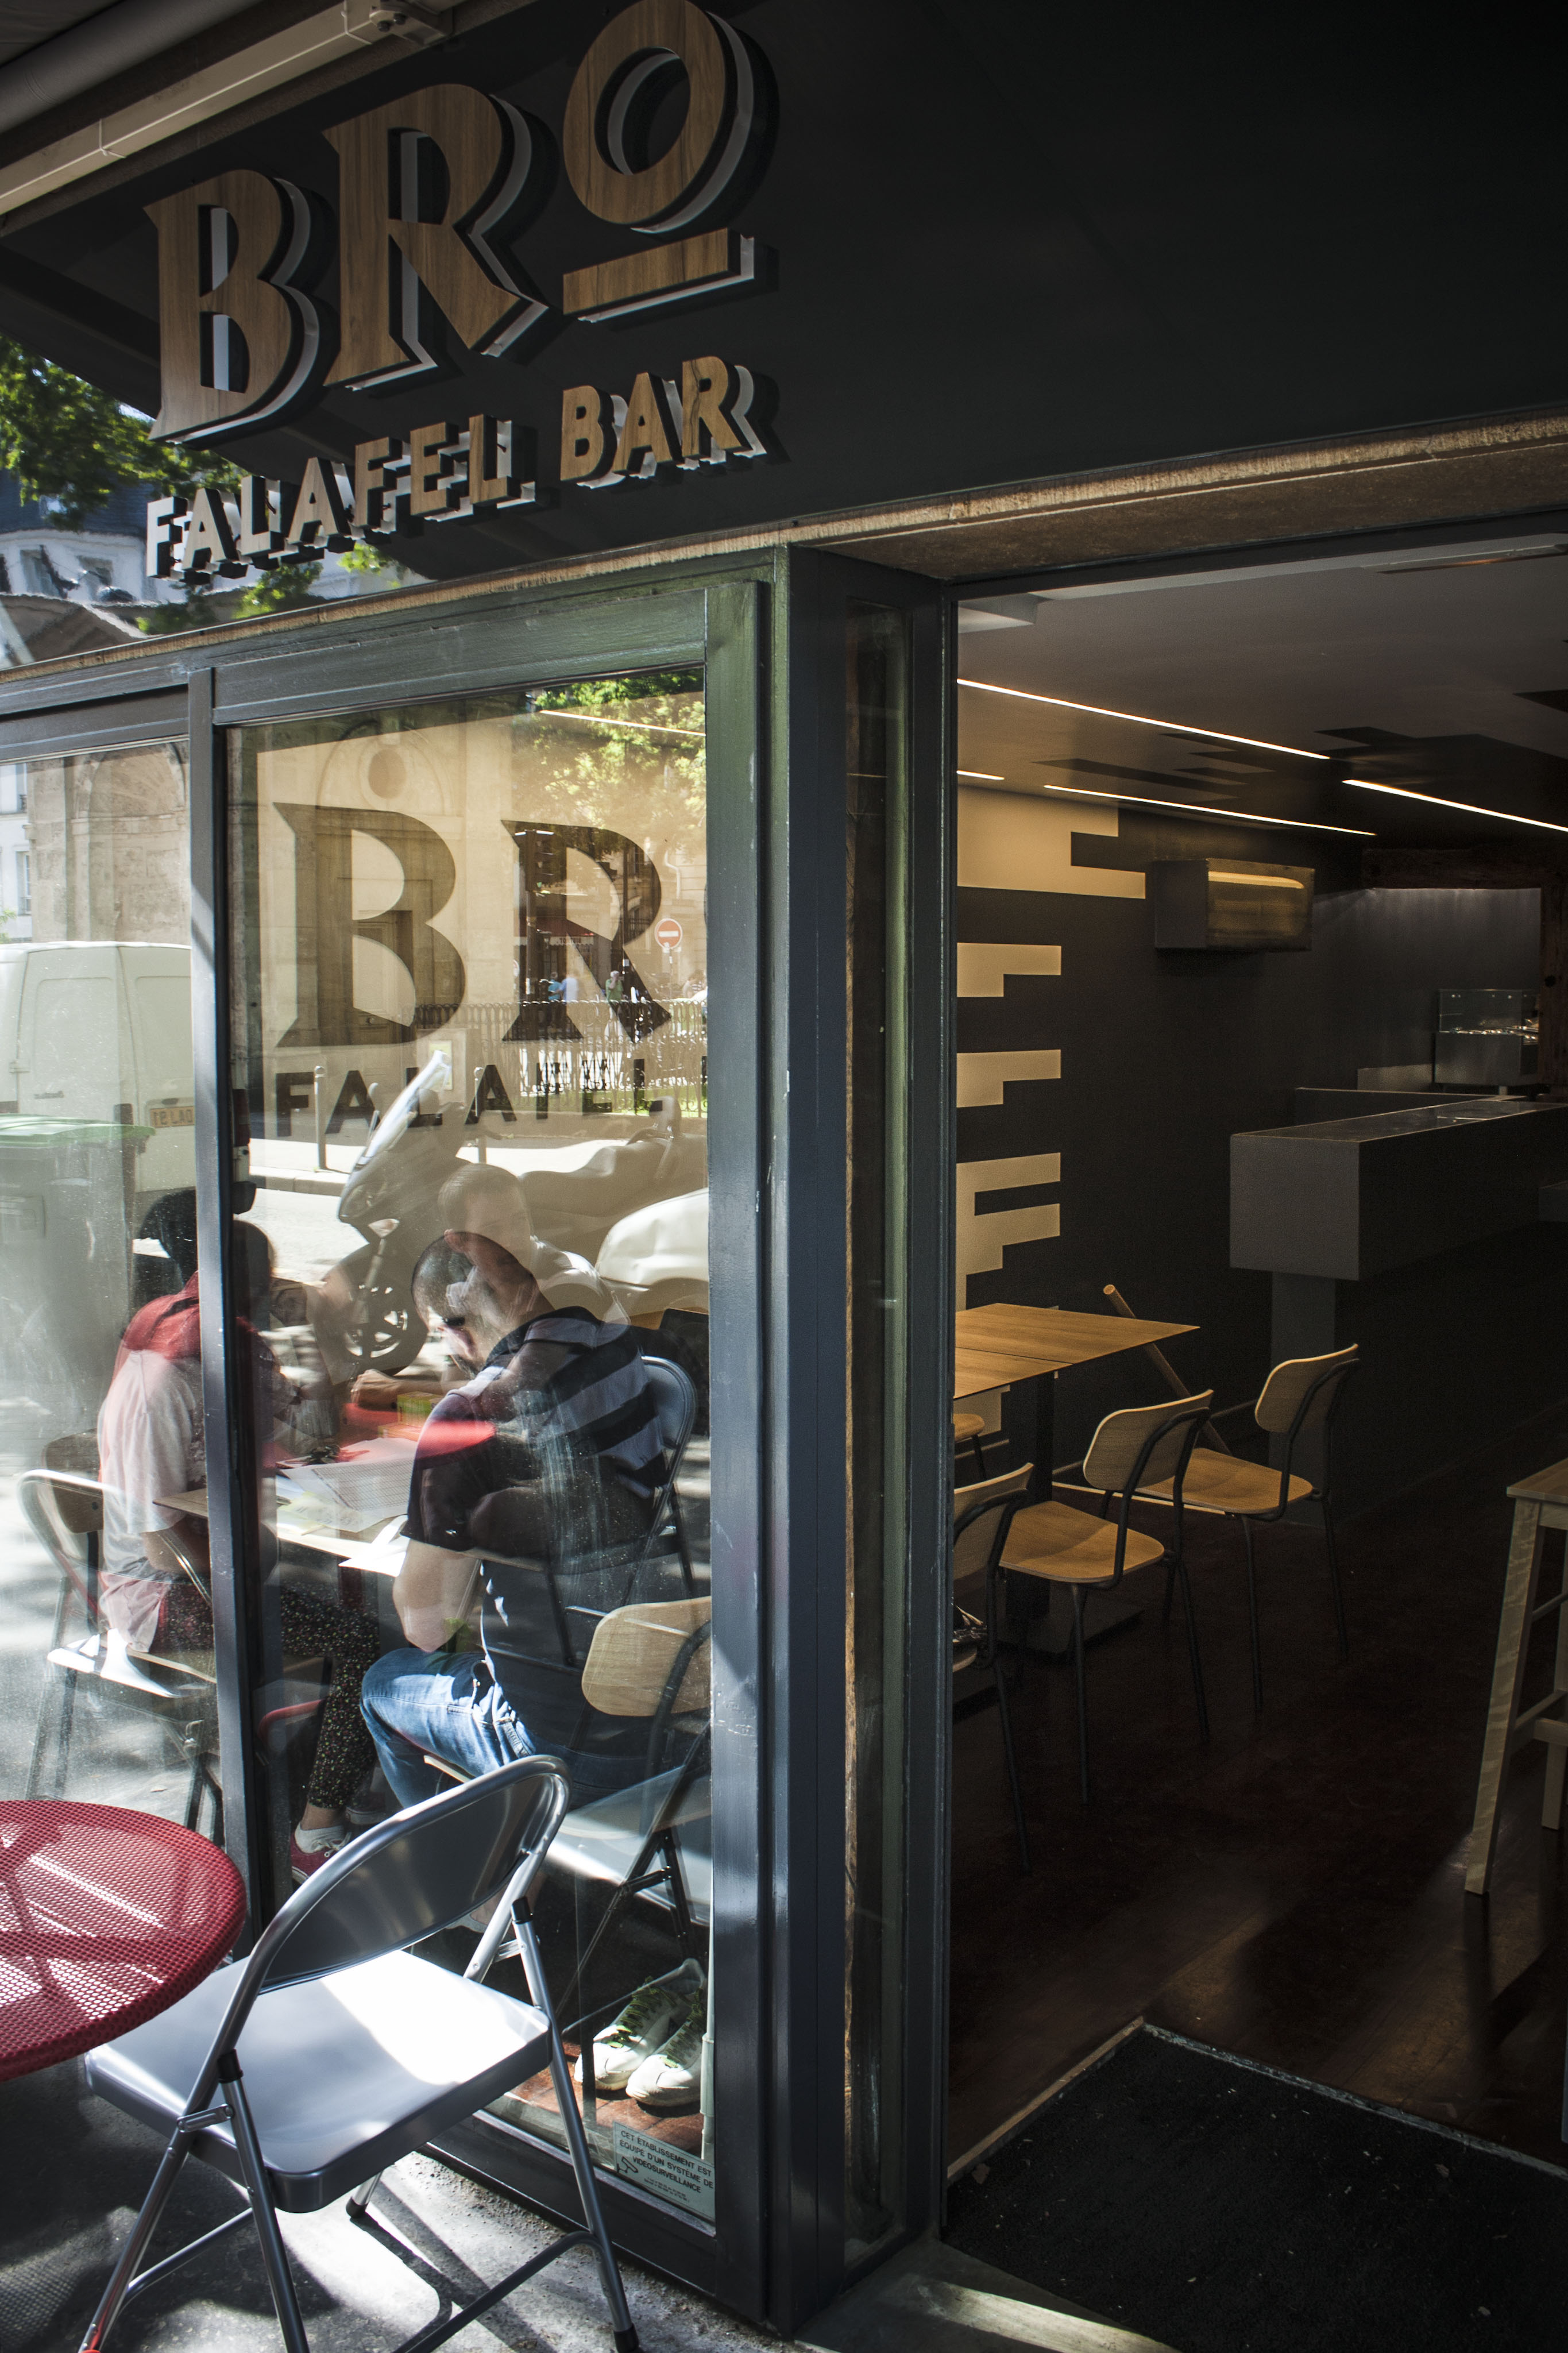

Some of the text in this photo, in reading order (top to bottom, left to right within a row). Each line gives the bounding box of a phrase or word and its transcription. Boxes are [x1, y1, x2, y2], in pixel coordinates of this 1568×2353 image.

[142, 0, 754, 443] BRO
[147, 355, 766, 579] FALAFEL BAR
[275, 1058, 664, 1137] FALAFEL
[621, 2130, 635, 2142] CET
[697, 2165, 712, 2177] EST
[647, 2153, 665, 2166] D'UN
[704, 2178, 714, 2189] DE
